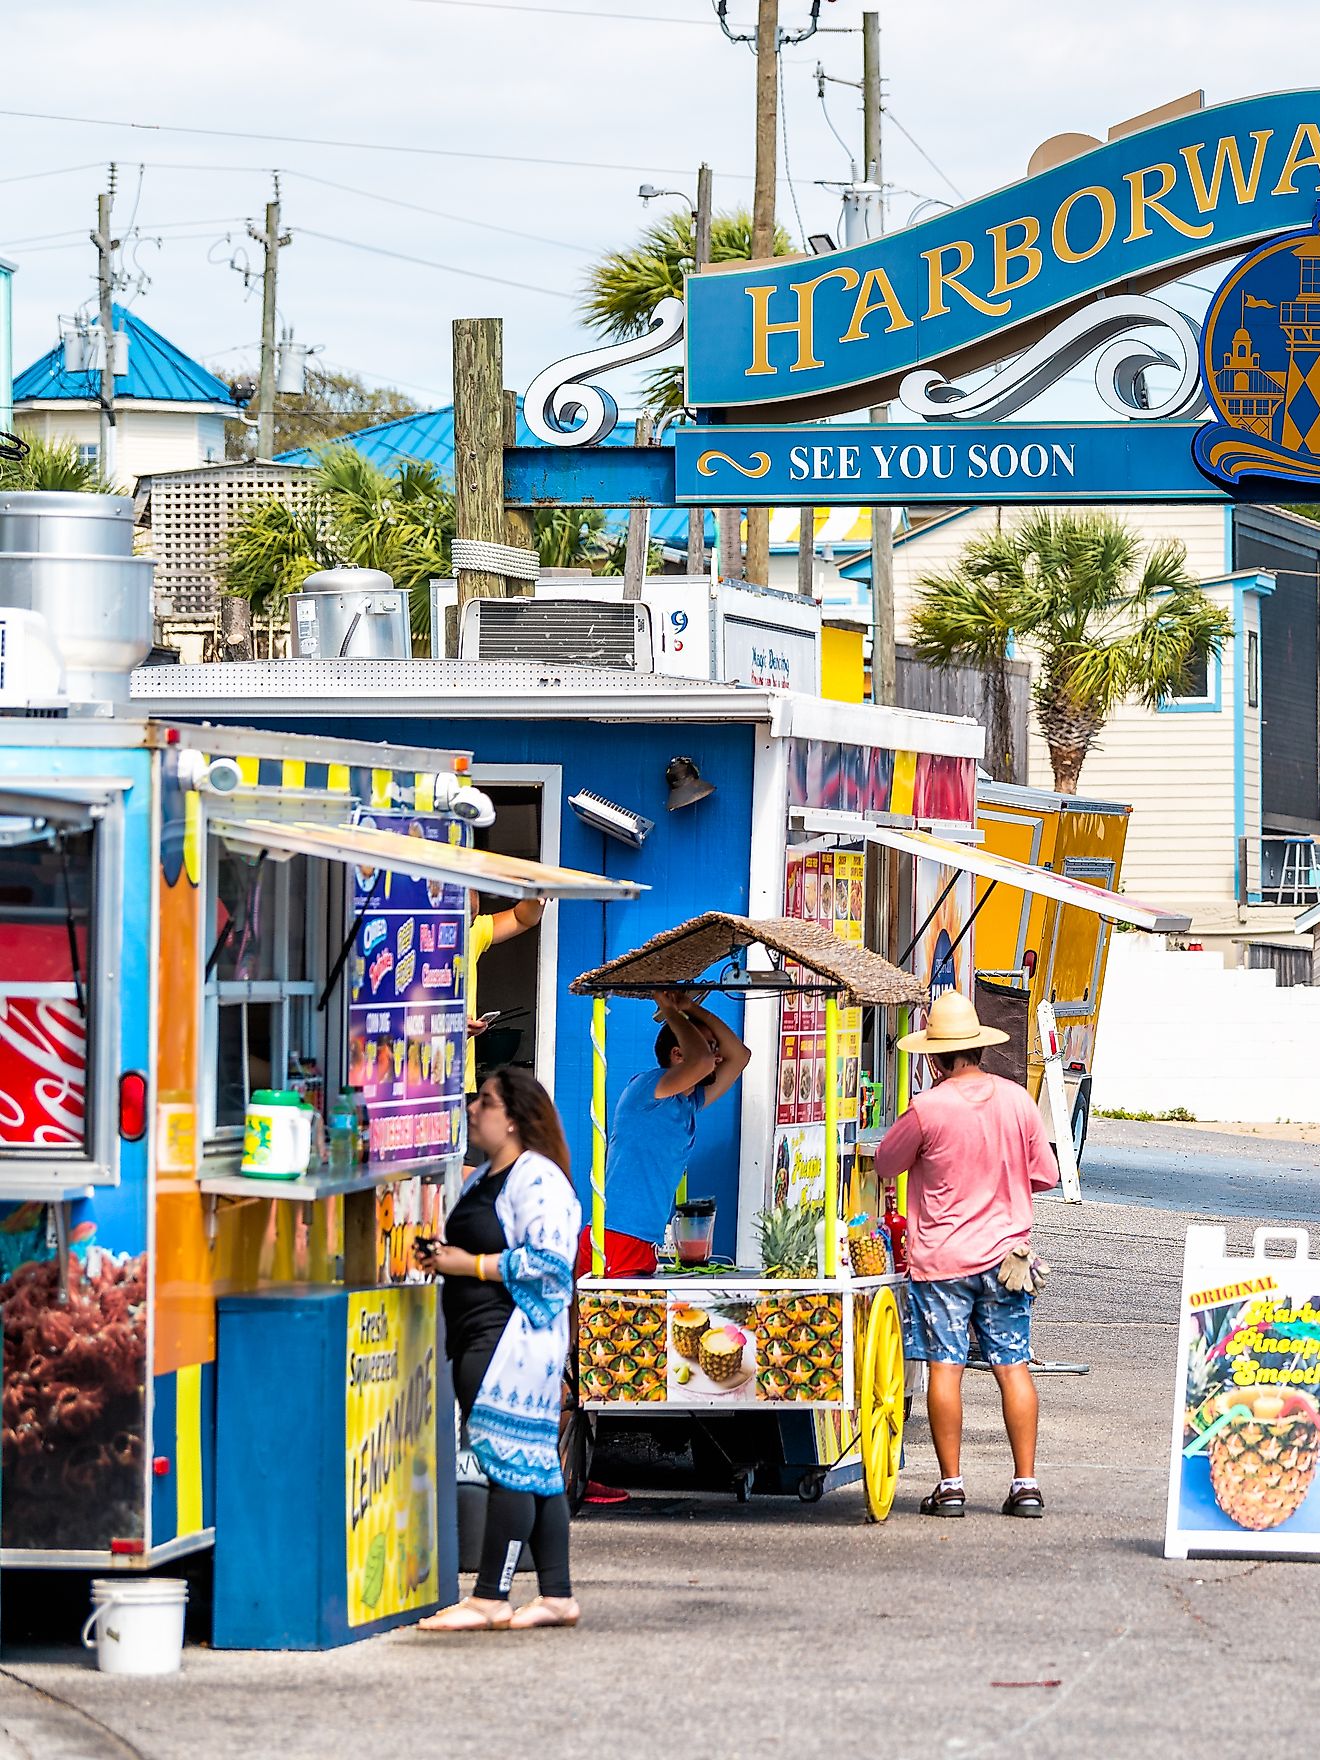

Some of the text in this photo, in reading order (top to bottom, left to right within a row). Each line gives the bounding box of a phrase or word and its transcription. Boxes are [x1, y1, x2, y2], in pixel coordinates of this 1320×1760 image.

[789, 443, 1076, 480] SEE YOU SOON
[1188, 1275, 1279, 1308] ORIGINAL
[360, 1302, 389, 1345] Fresh
[351, 1346, 433, 1532] LEMONADE
